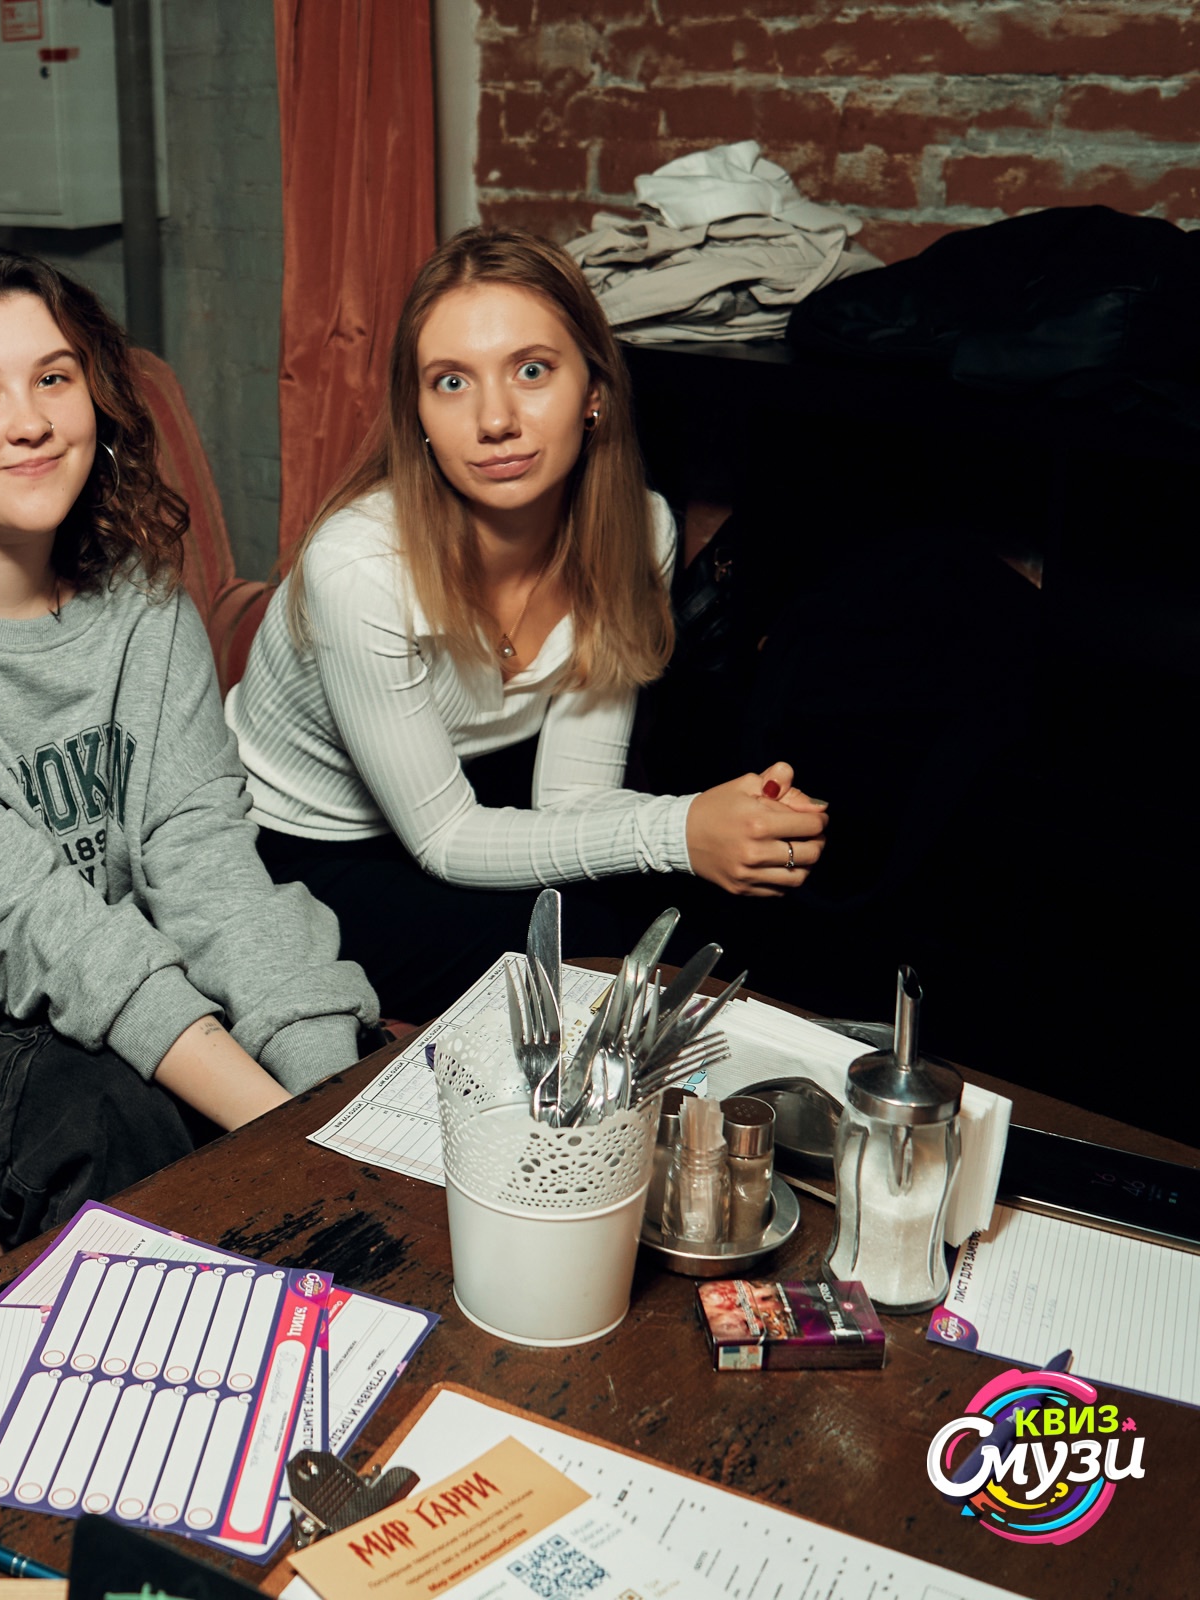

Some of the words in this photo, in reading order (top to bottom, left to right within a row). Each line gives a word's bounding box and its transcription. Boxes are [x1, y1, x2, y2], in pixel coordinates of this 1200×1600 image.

[964, 1228, 982, 1262] ЗАМЕТО
[960, 1262, 974, 1280] ДЛЯ
[817, 1282, 834, 1304] ORRIS
[954, 1279, 969, 1303] ЛИСТ
[828, 1310, 845, 1333] PHILI
[329, 1415, 355, 1452] ПРЕДЛ
[347, 1519, 417, 1569] МИР
[406, 1471, 504, 1531] ГАРРИ
